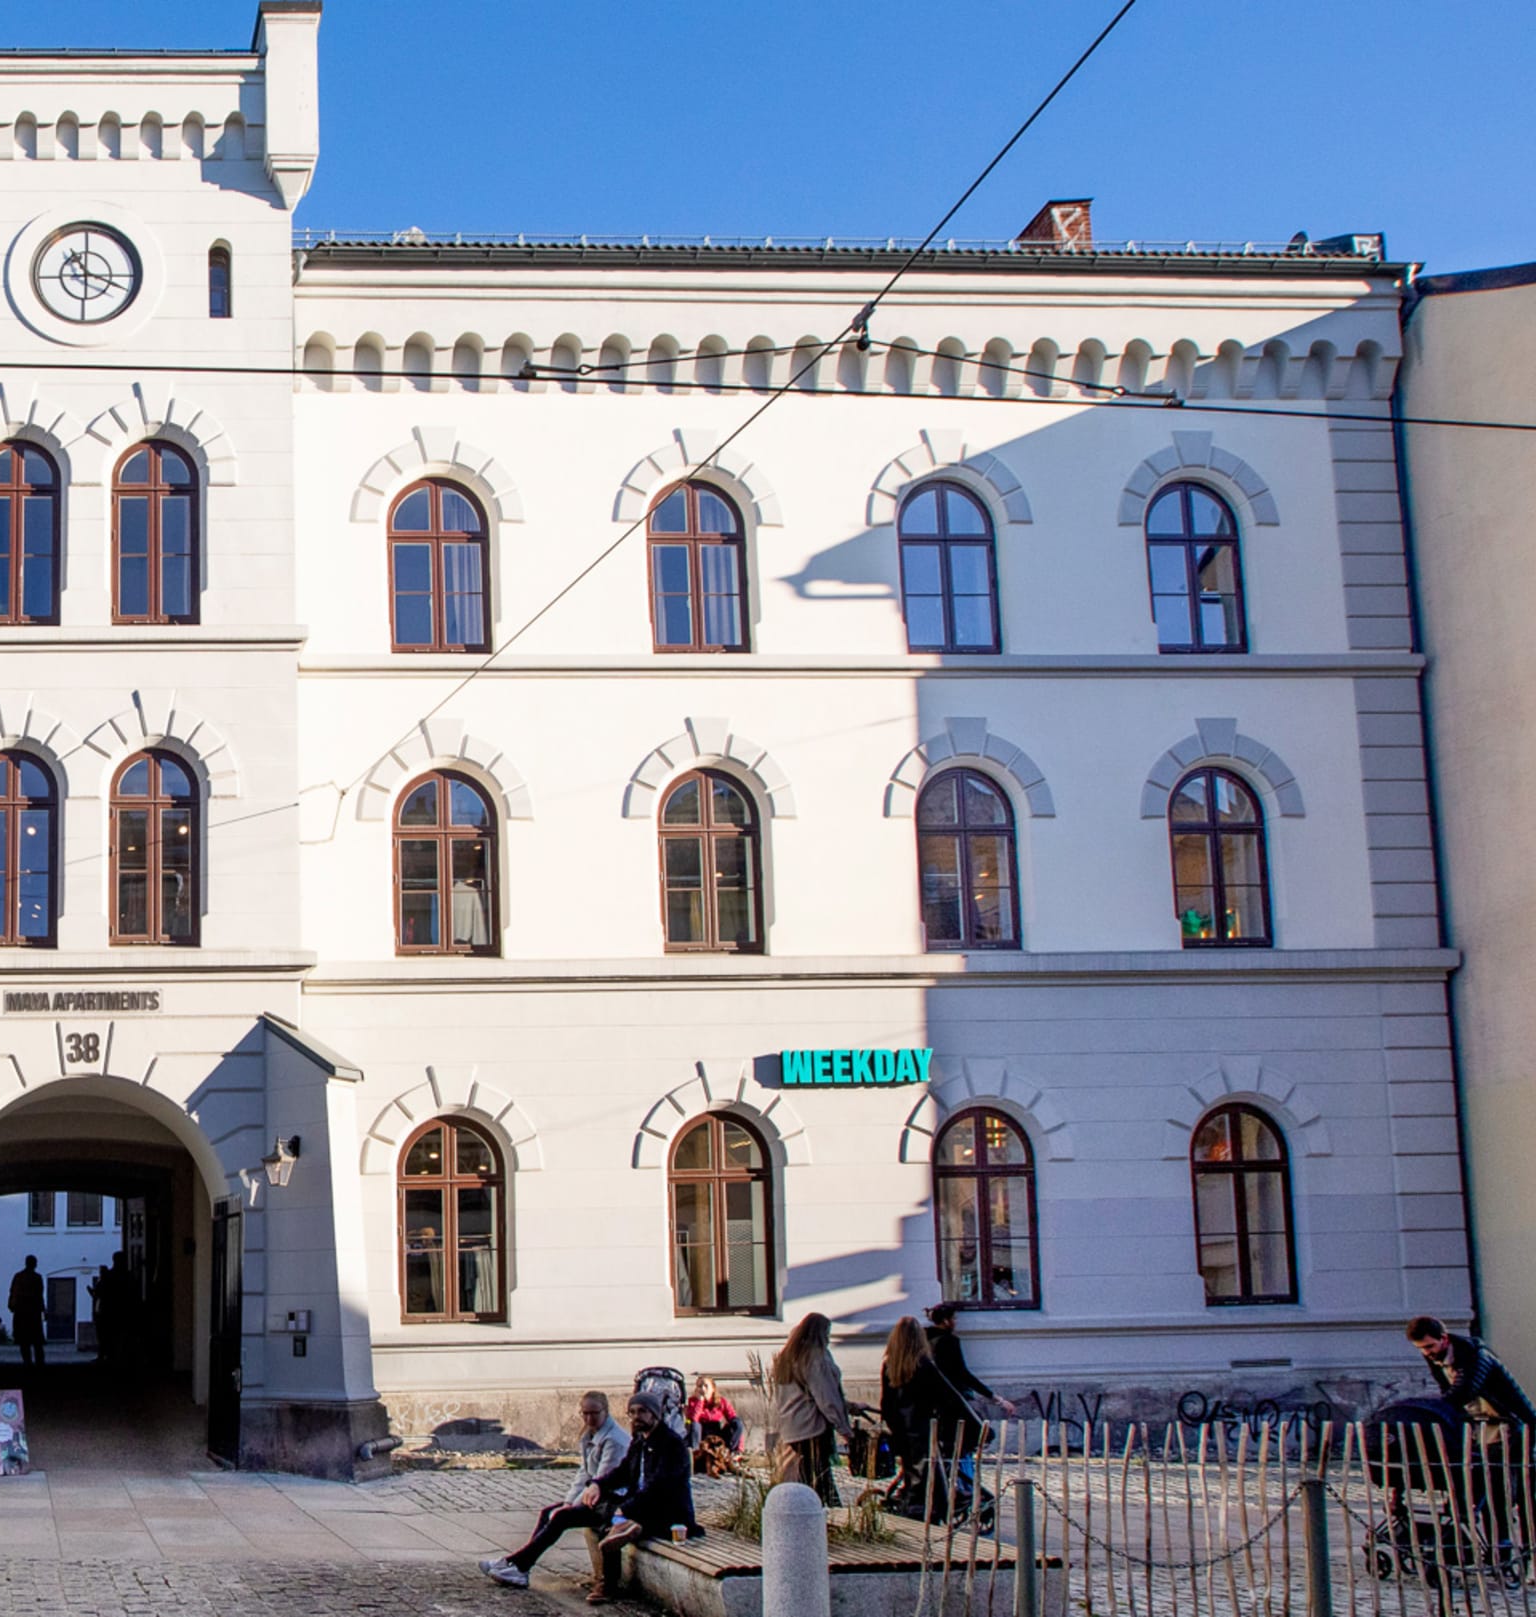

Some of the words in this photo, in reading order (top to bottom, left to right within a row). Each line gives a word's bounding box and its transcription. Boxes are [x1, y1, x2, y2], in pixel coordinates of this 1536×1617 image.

[5, 992, 50, 1012] MAYA
[52, 991, 160, 1011] APARTMENTS
[65, 1032, 100, 1063] 38
[780, 1048, 933, 1086] WEEKDAY
